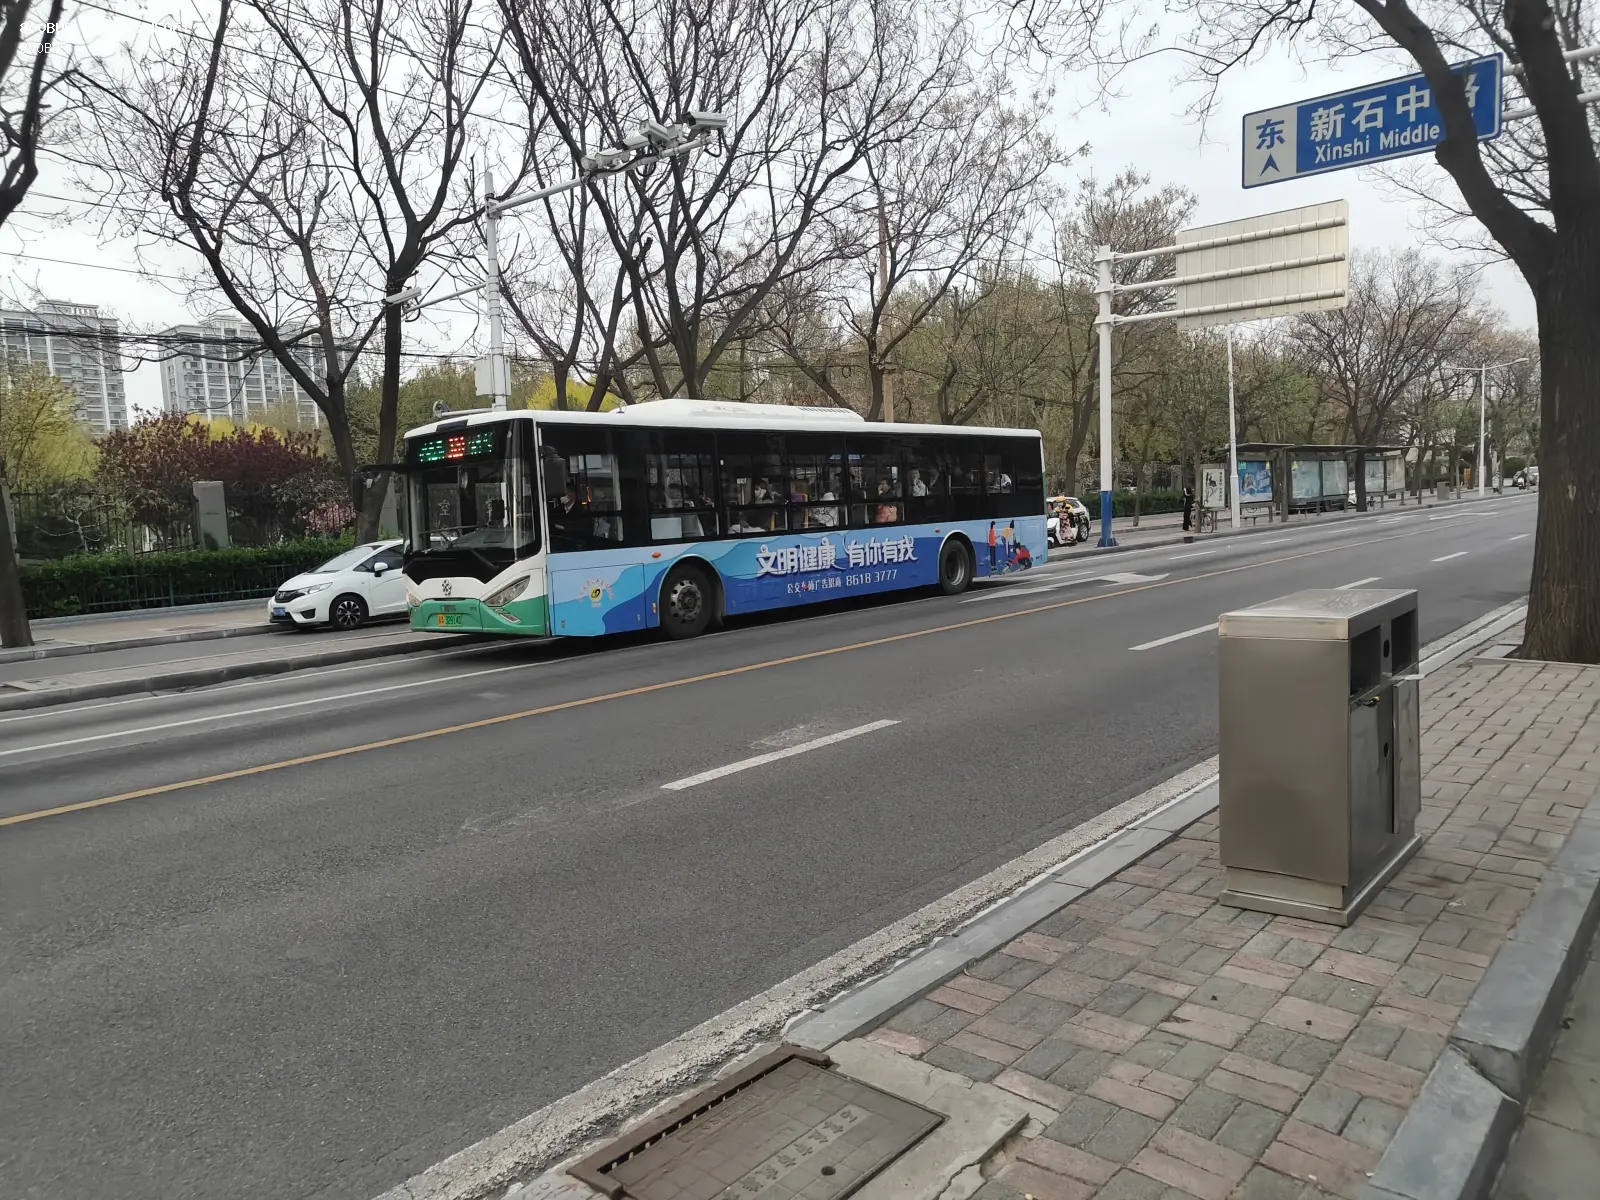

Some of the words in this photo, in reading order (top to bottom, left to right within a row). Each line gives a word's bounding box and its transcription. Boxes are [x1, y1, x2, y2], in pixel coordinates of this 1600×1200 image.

[1256, 118, 1286, 150] 东
[1315, 136, 1370, 164] Xinshi
[1379, 123, 1440, 151] Middle
[756, 537, 846, 577] 文明健康
[846, 534, 918, 568] 有你有我
[846, 573, 872, 587] 8618
[874, 569, 898, 583] 3777
